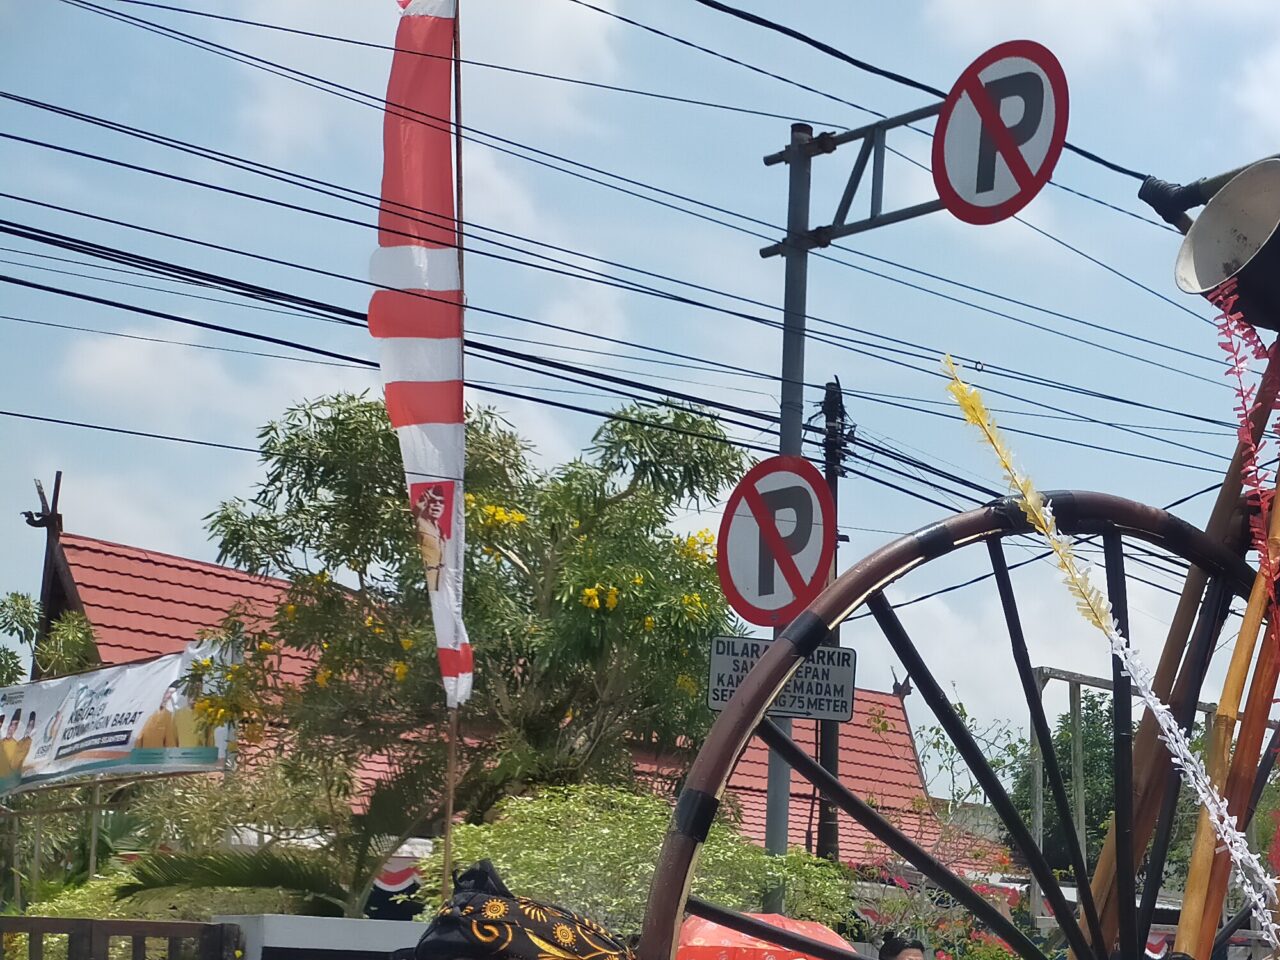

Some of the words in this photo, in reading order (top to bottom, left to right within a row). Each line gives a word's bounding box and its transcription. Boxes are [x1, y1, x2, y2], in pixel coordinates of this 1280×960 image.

[805, 649, 852, 668] ARKIR
[797, 666, 830, 681] EPAN
[784, 679, 845, 698] EMADAM
[789, 695, 804, 709] 75
[807, 698, 848, 713] METER
